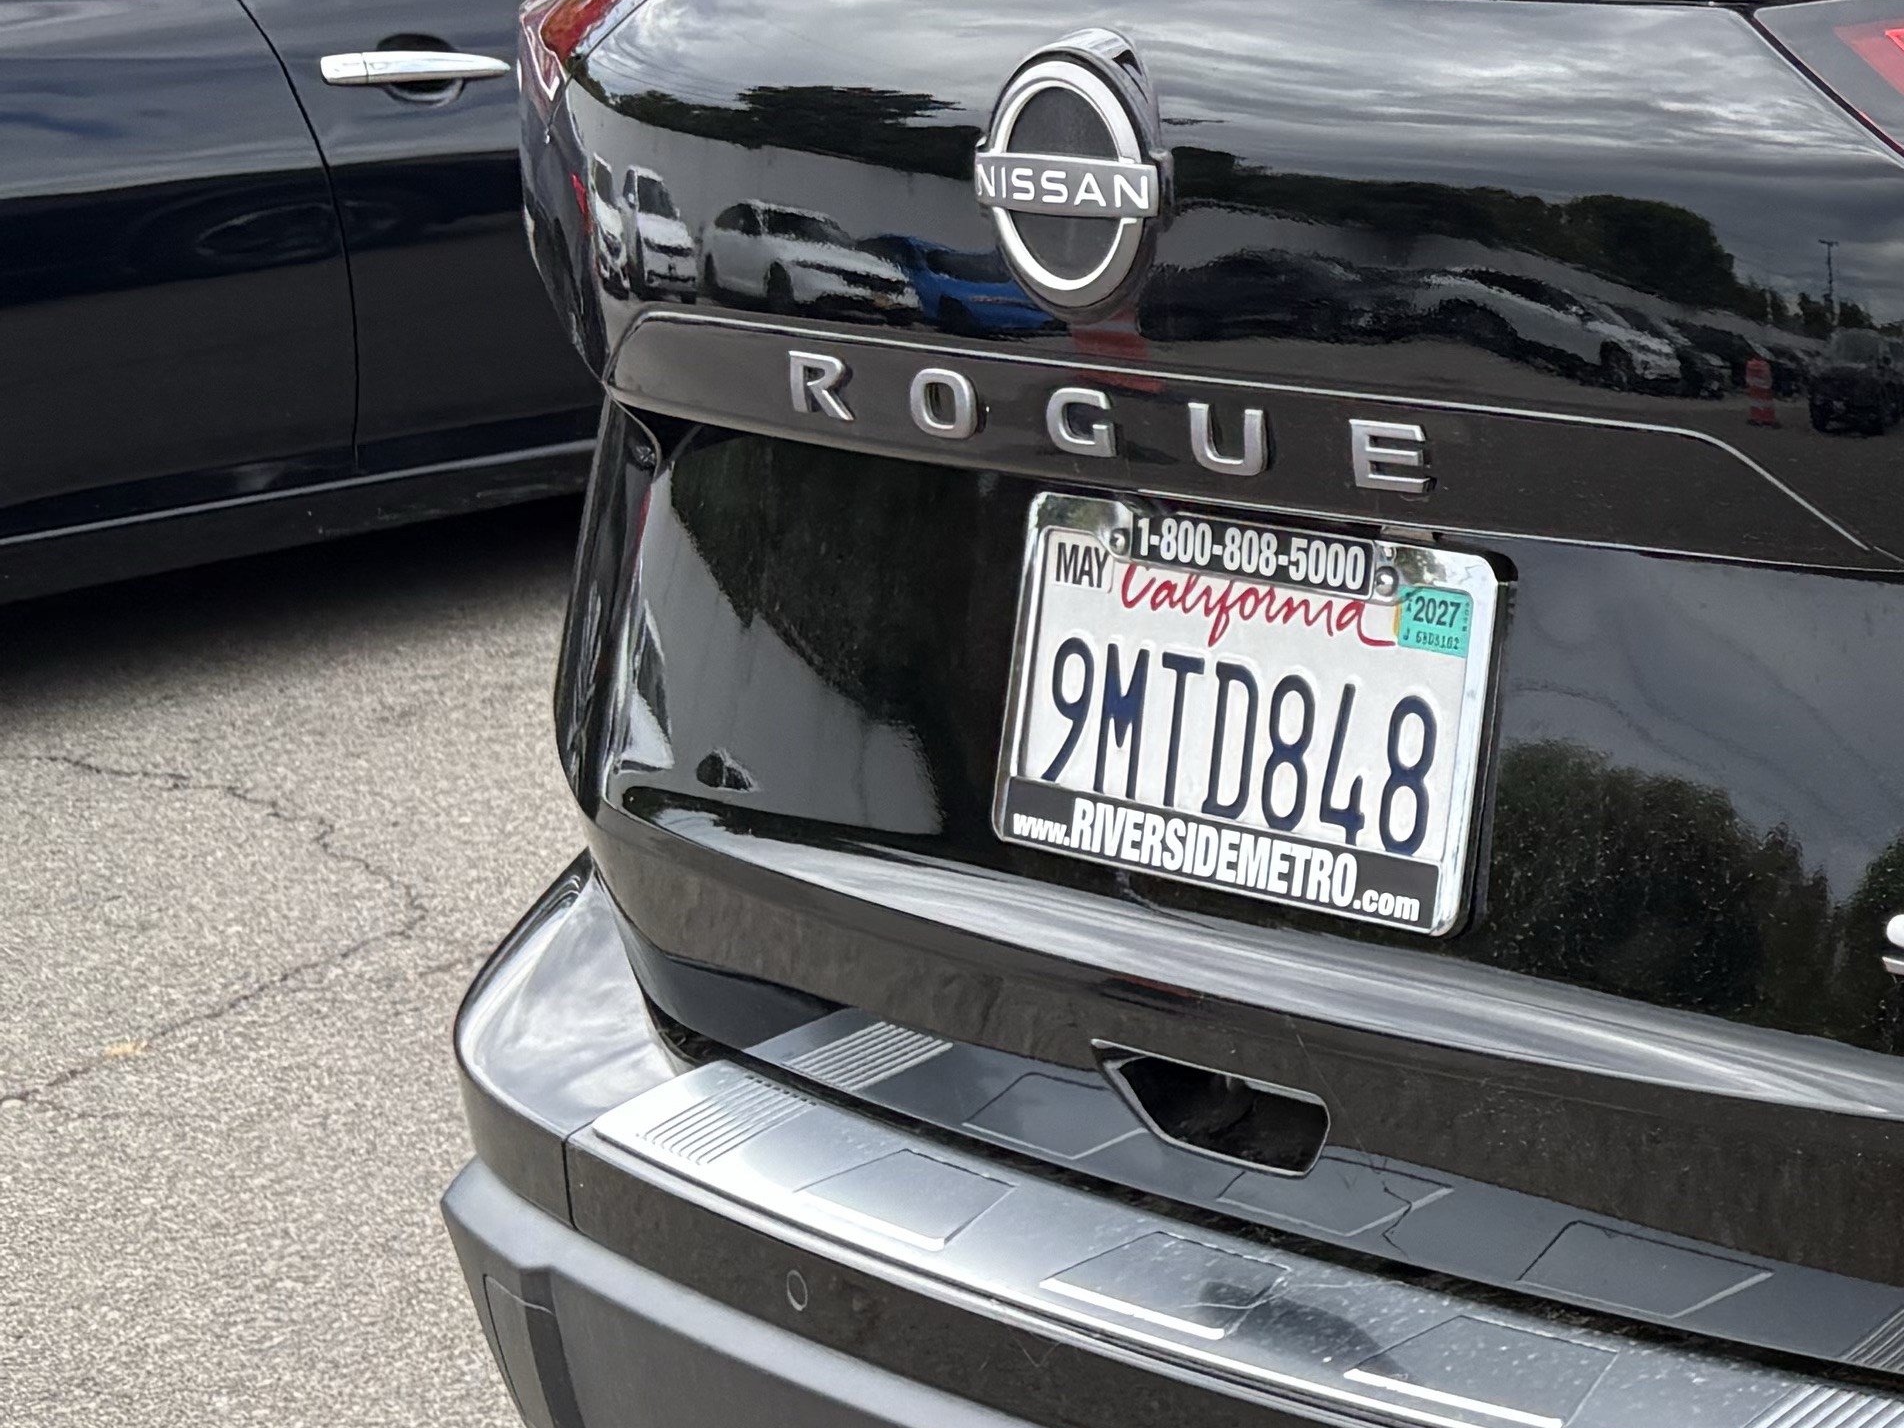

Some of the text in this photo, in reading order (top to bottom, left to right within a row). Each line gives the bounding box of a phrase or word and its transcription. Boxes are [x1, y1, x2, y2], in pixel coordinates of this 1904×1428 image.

[976, 164, 1151, 210] NISSAN
[788, 350, 1432, 493] ROGUE
[1055, 541, 1109, 589] MAY
[1137, 517, 1367, 591] 1-800-808-5000
[1121, 563, 1396, 647] California
[1412, 595, 1462, 629] 2027
[1039, 637, 1438, 856] 9MTD848
[1012, 798, 1420, 922] www.RIVERSIDEMETRO.com
